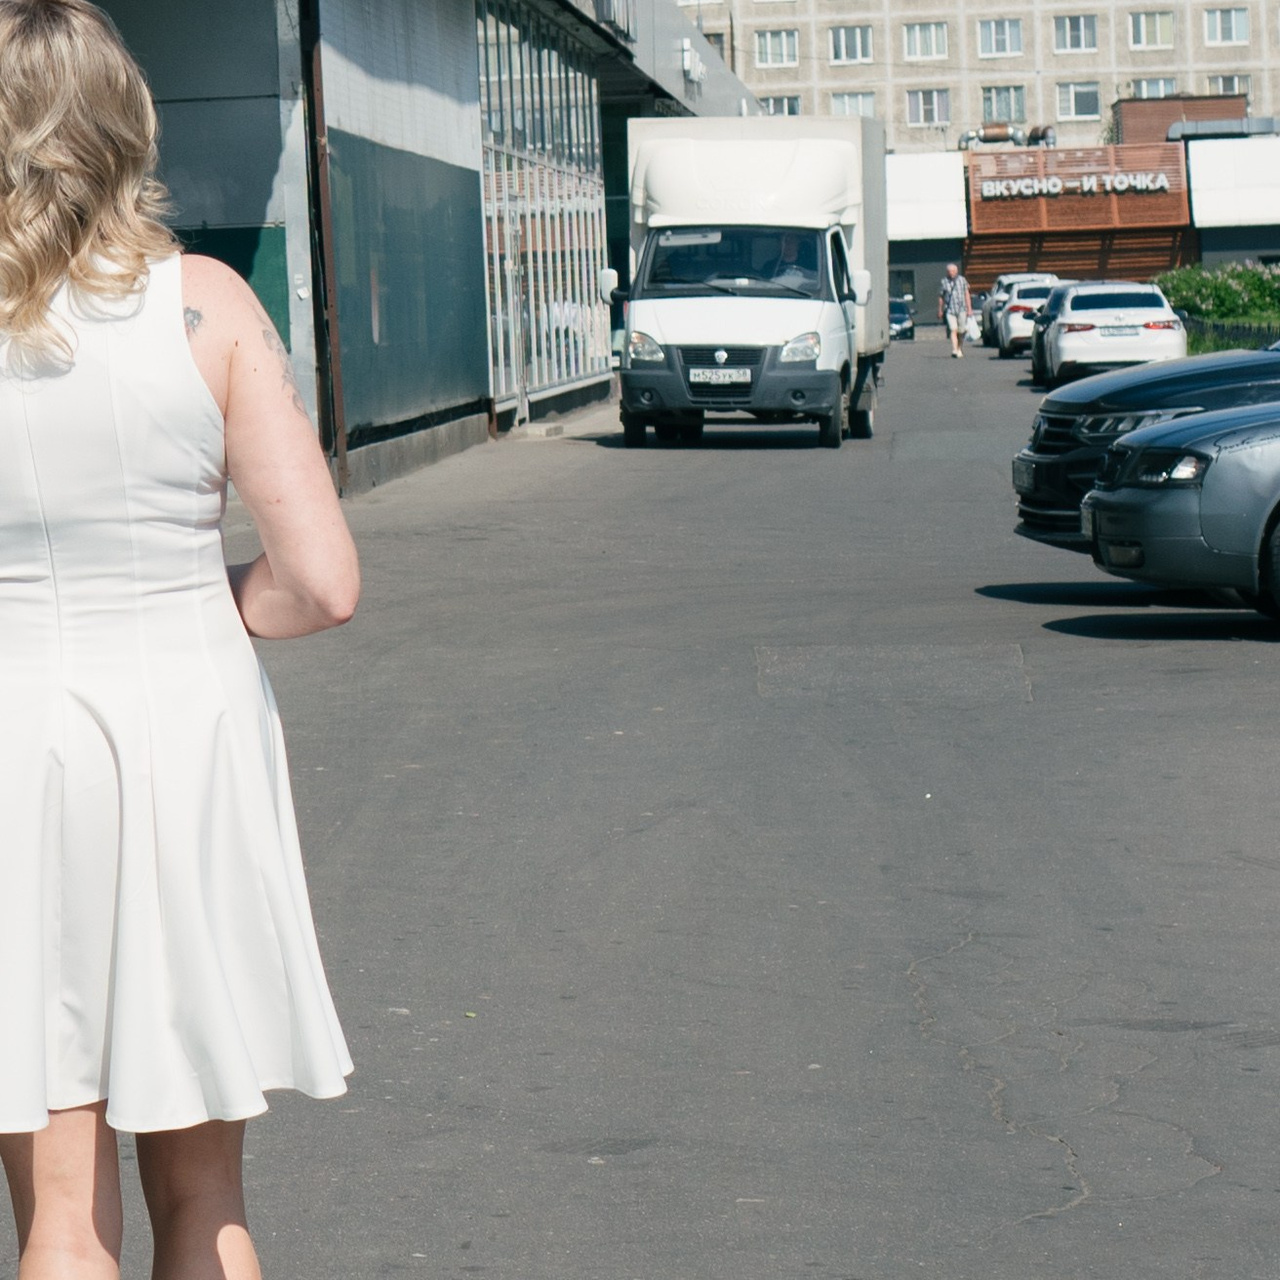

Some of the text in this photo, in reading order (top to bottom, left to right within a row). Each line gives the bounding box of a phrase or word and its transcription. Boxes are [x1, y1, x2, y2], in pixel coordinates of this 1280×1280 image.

[981, 177, 1063, 198] ВКУСНО
[1082, 176, 1098, 191] И
[1102, 173, 1170, 192] ТОЧКА
